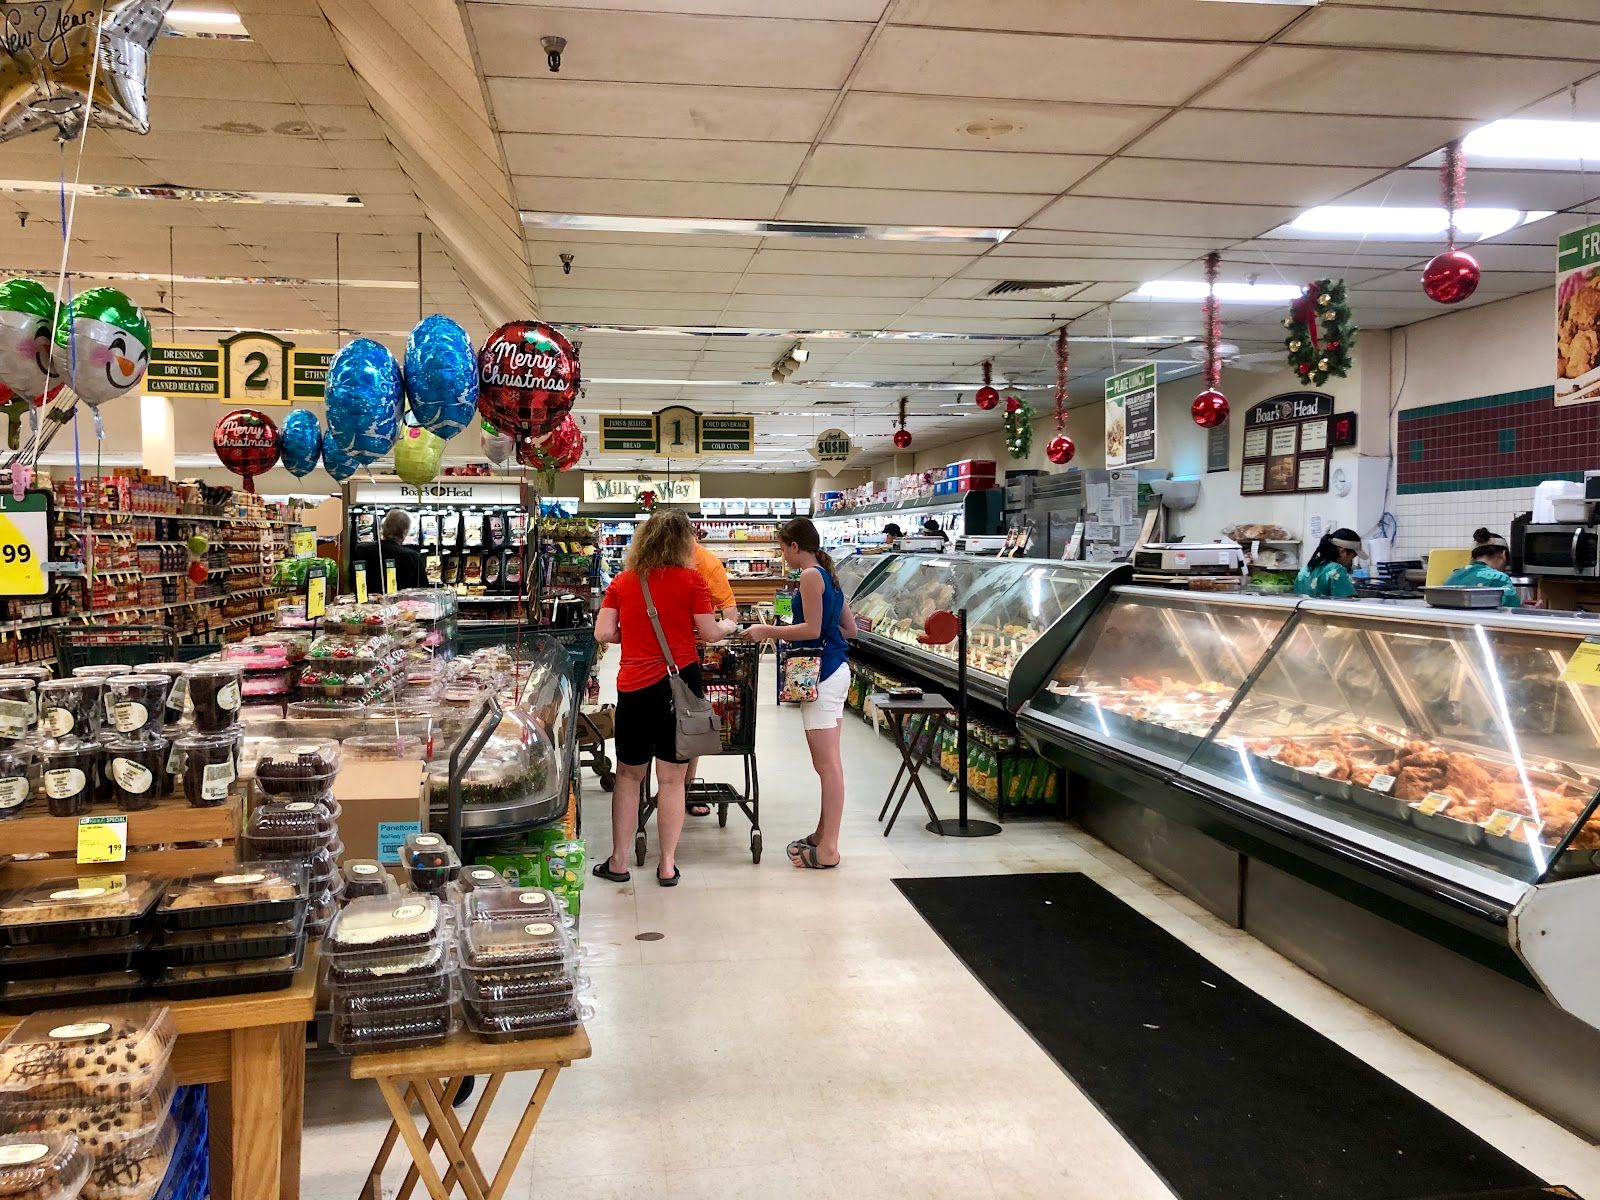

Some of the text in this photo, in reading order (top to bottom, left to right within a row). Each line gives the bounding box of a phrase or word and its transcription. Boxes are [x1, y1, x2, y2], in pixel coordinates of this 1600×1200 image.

[34, 5, 95, 65] Year
[163, 350, 204, 359] DRESSINGS
[495, 341, 556, 377] Merry
[164, 365, 202, 376] DRY PASTA
[244, 351, 269, 390] 2
[304, 370, 328, 379] ETHNI
[482, 363, 569, 391] Christmas
[151, 381, 214, 392] CANNED MEAT & FISH
[1255, 396, 1319, 423] Boar's Head
[224, 420, 264, 439] Merry
[672, 420, 684, 445] 1
[705, 420, 747, 428] COLD BEVERAGE
[217, 435, 273, 447] Christmas
[818, 441, 849, 453] SUSHI
[446, 486, 473, 497] Head
[594, 480, 690, 500] Milky Way
[2, 544, 31, 563] 99
